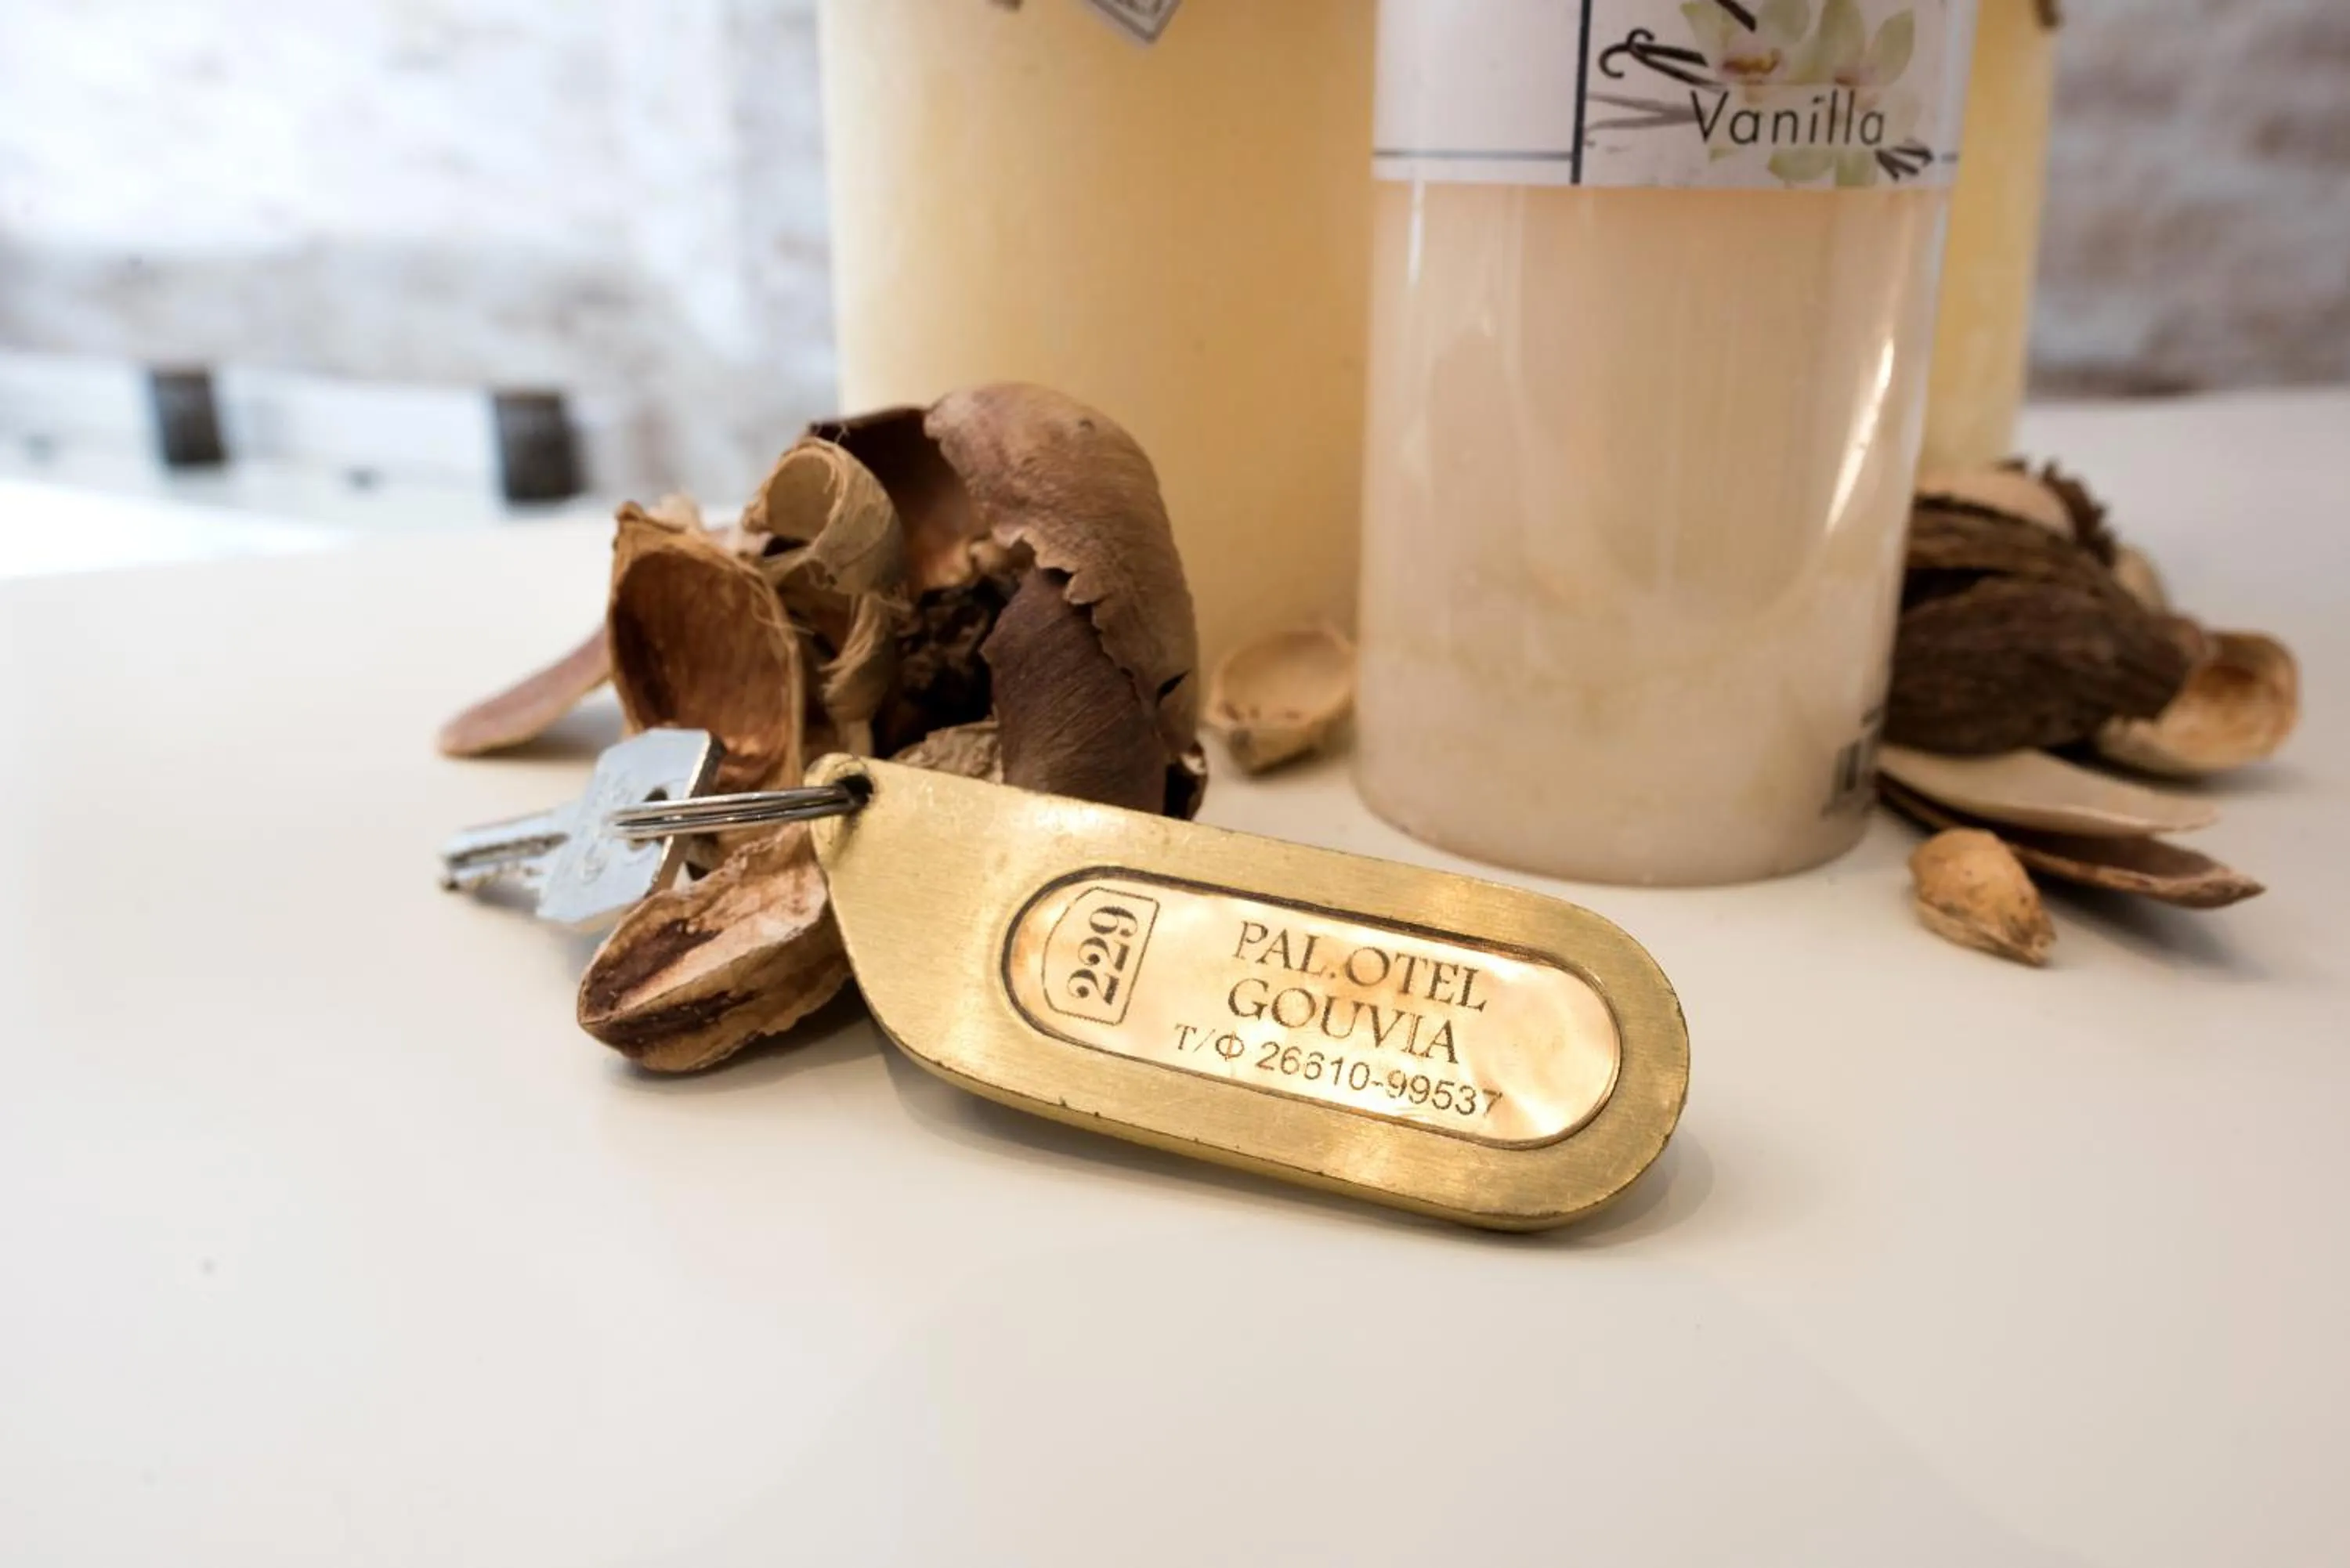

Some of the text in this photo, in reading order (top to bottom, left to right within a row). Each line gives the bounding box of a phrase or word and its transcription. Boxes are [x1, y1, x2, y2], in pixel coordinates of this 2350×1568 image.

[1690, 89, 1885, 145] Vanilla
[1067, 905, 1138, 1006] 229
[1228, 977, 1459, 1064] GOUVIA
[1256, 1041, 1503, 1117] 26610-99537
